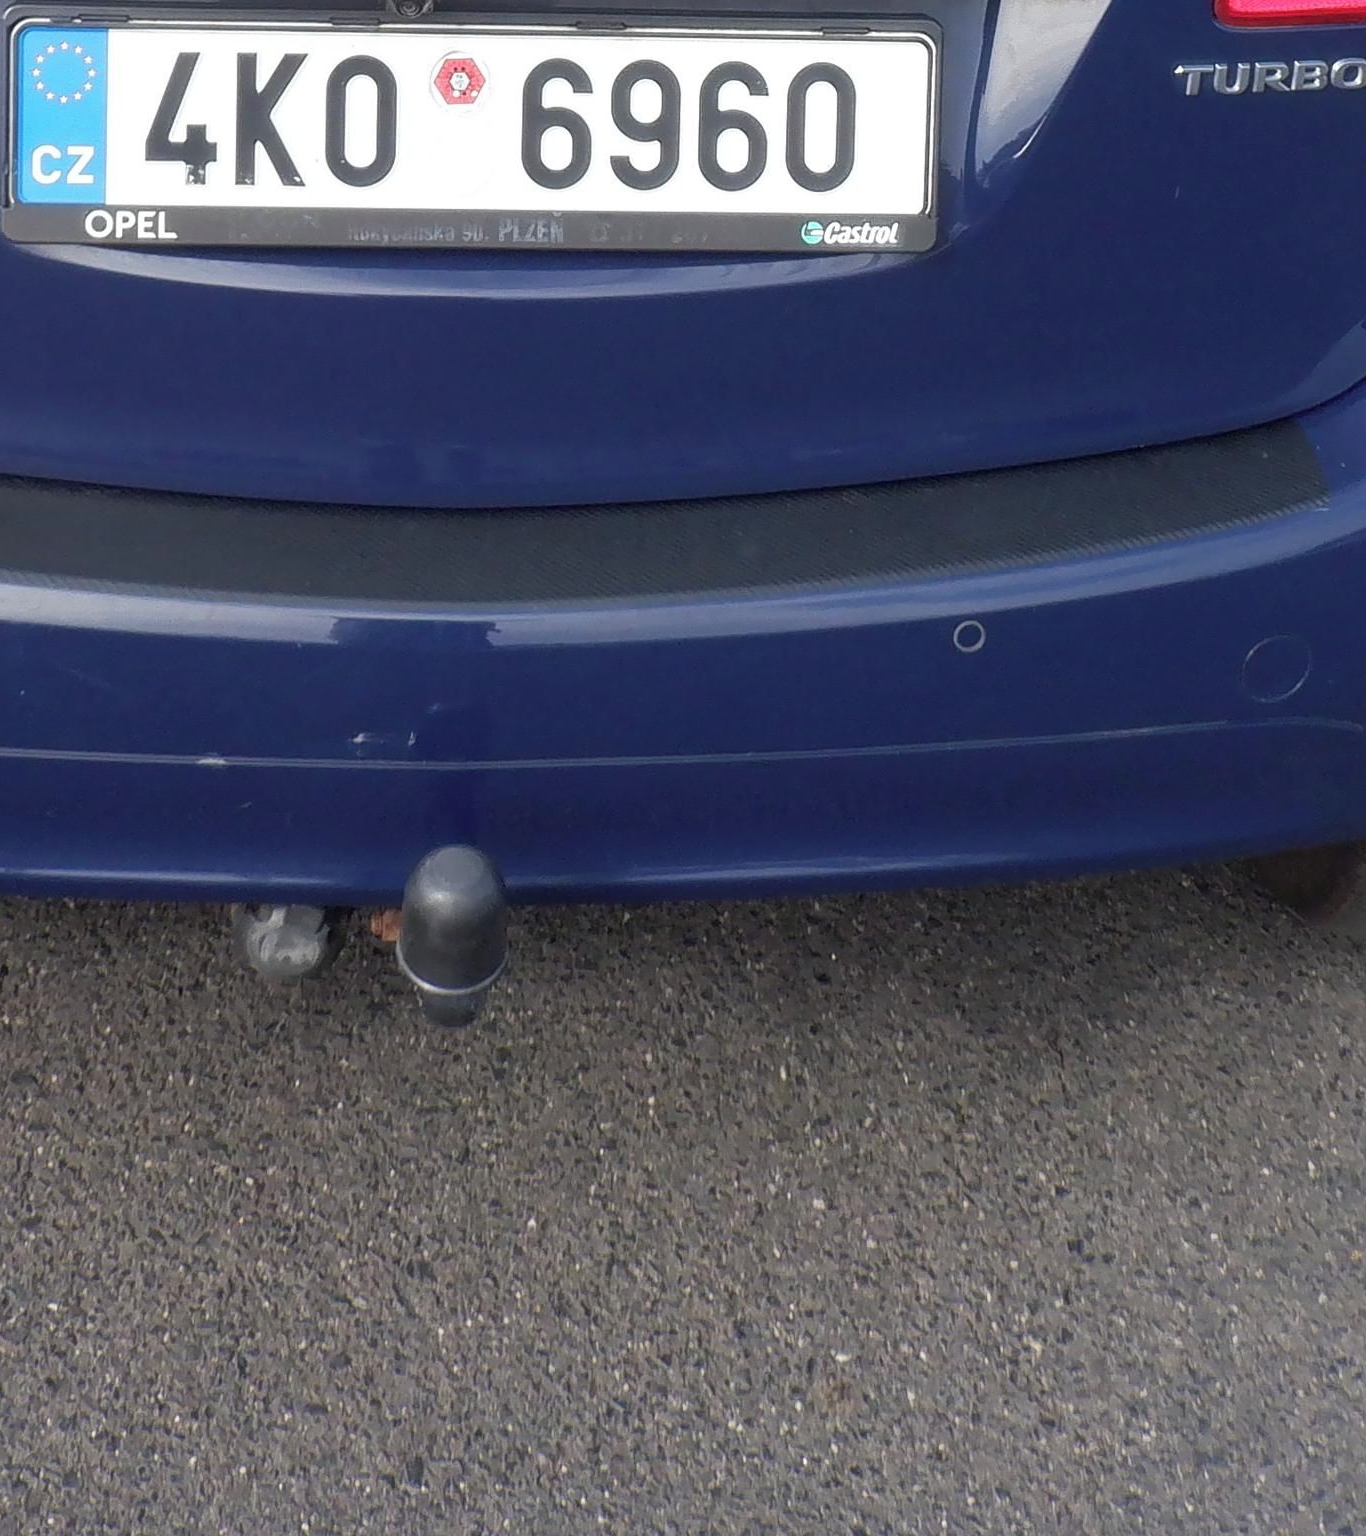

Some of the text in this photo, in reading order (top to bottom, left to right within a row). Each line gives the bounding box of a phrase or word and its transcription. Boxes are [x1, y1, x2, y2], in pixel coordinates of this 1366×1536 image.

[521, 57, 857, 193] 6960
[31, 144, 96, 185] CZ
[84, 209, 179, 240] OPEL
[823, 221, 900, 245] Castrol
